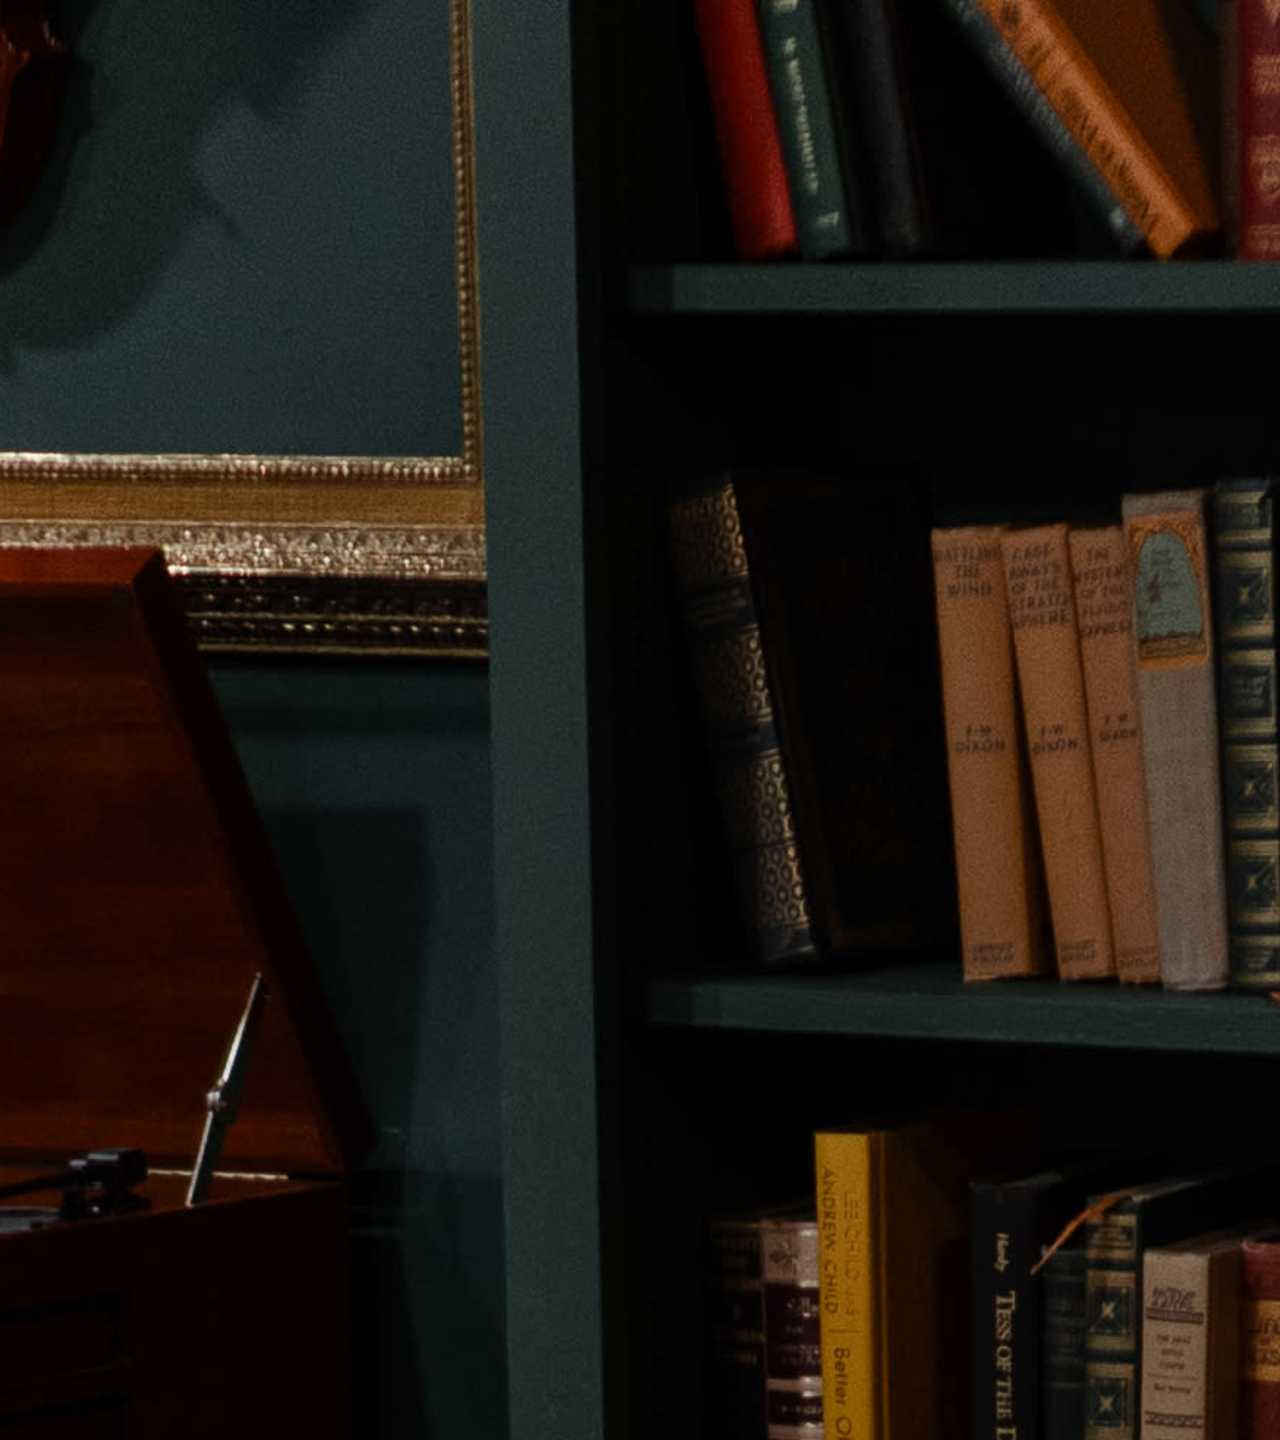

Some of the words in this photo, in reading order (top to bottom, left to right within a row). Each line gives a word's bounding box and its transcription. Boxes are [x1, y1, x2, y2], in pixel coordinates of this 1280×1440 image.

[822, 1168, 838, 1250] ANDREW
[823, 1259, 839, 1314] CHILD
[833, 1347, 851, 1405] Better
